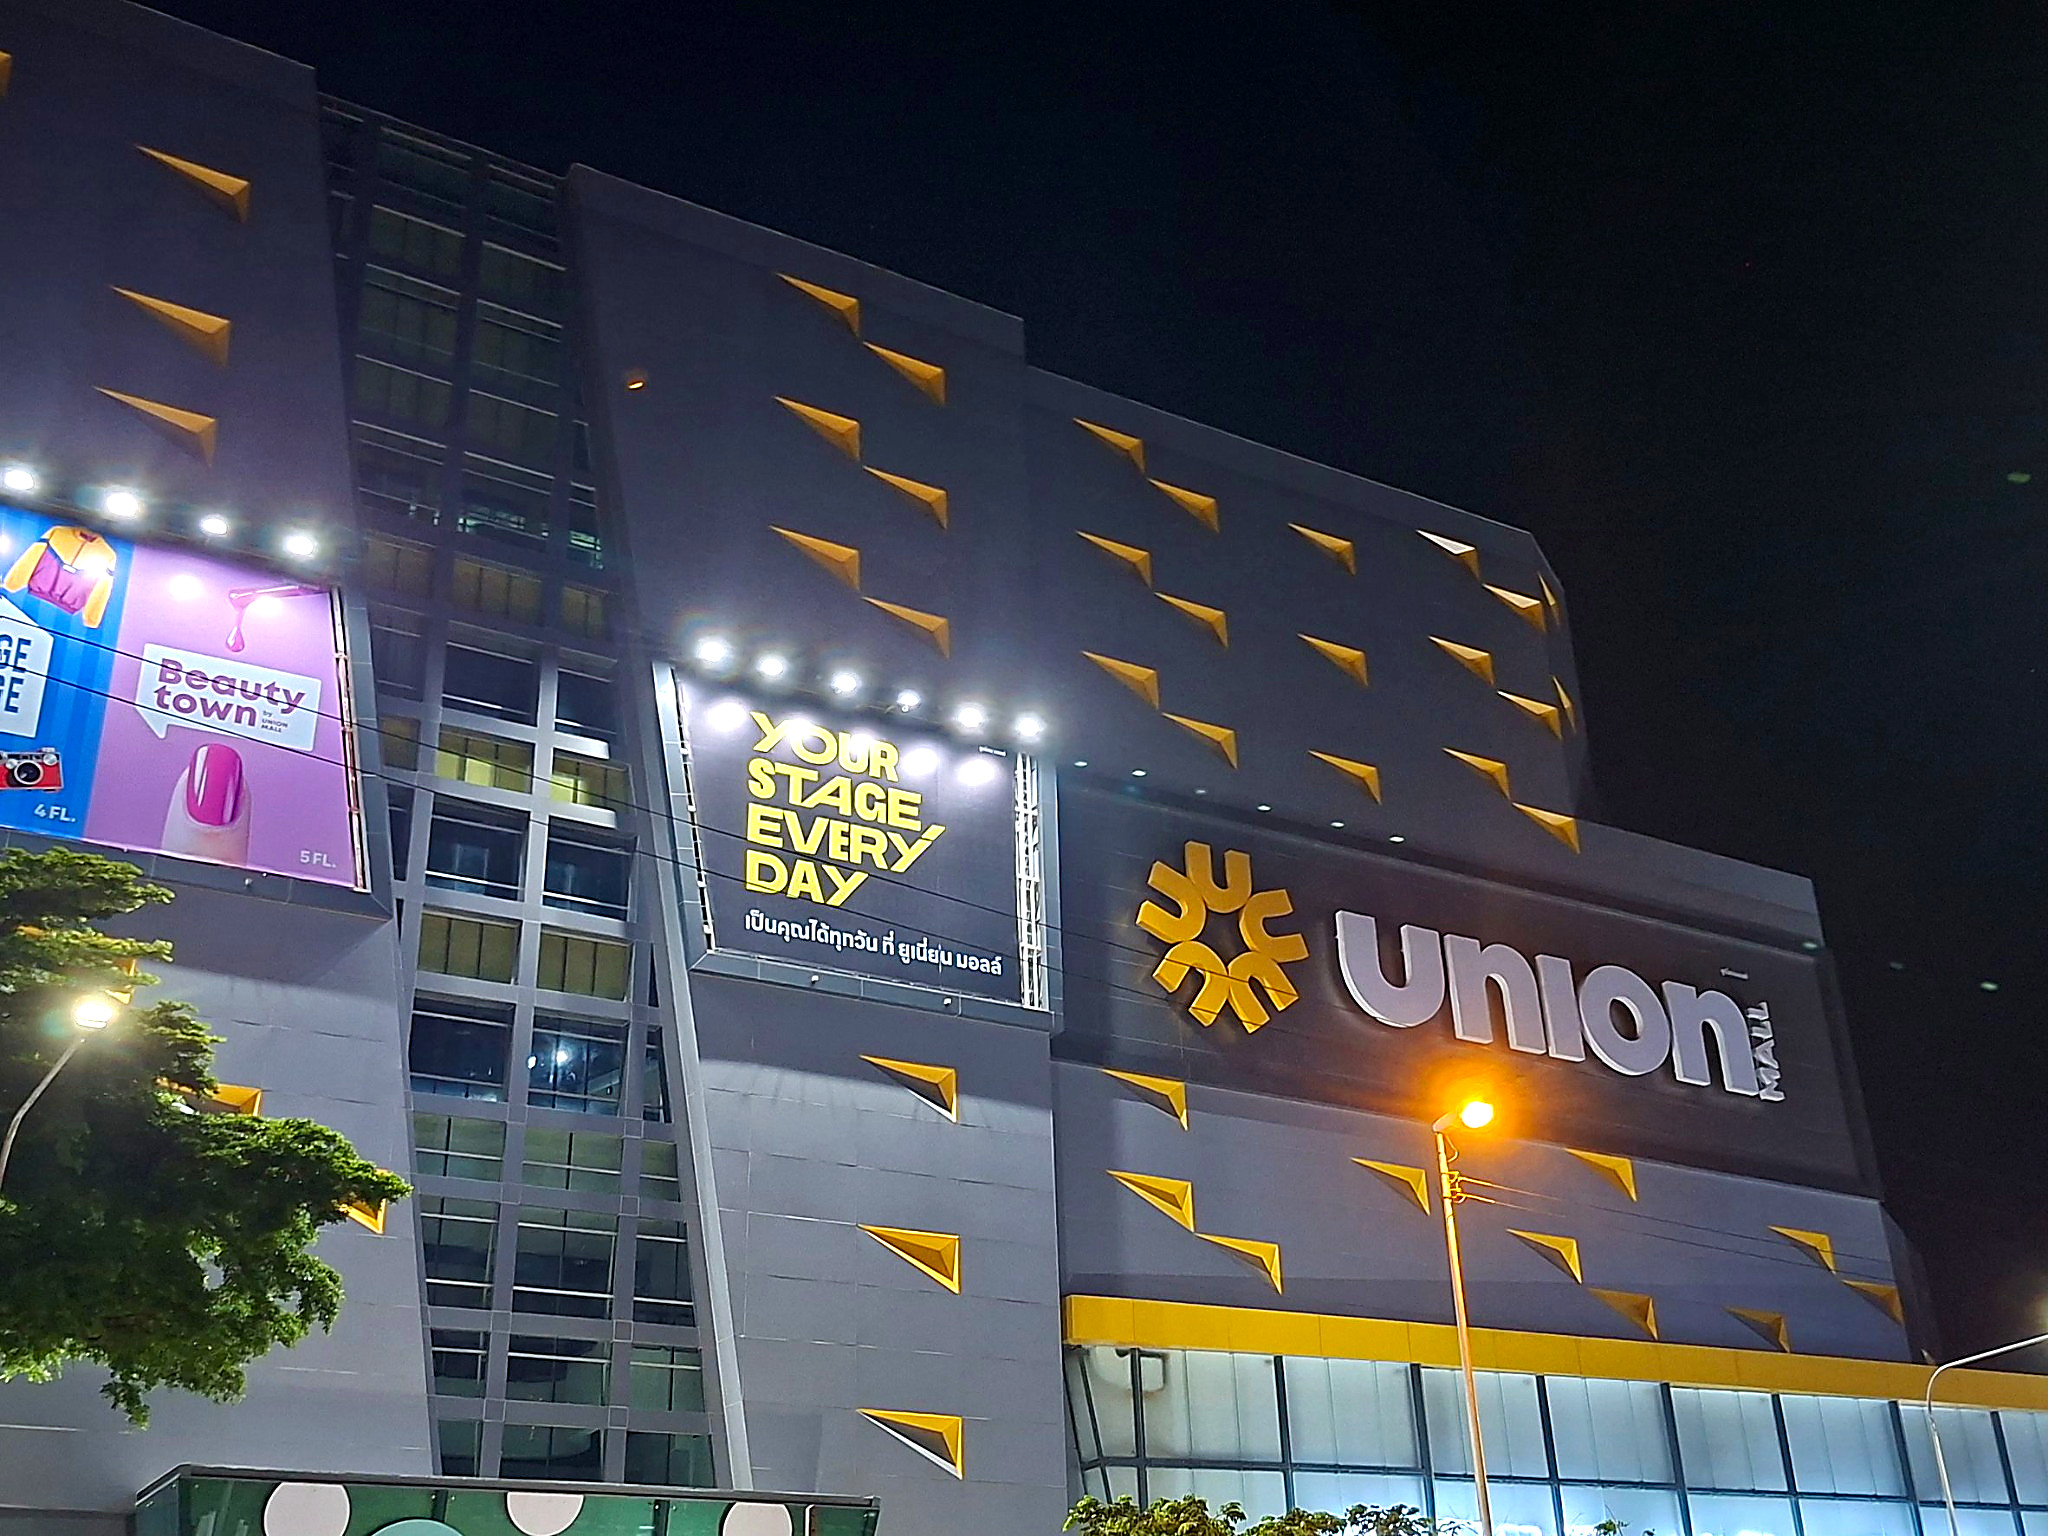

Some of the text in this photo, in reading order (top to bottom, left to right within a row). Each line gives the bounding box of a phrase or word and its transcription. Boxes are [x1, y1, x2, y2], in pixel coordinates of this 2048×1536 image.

[154, 685, 258, 727] town
[159, 658, 306, 714] Beauty
[261, 724, 282, 733] MALL
[262, 718, 288, 728] UNION
[750, 711, 899, 782] YOUR
[33, 803, 76, 823] 4 FL.
[748, 757, 922, 831] STAGE
[299, 850, 337, 868] 5 FL.
[747, 802, 946, 873] EVERY
[746, 849, 869, 907] DAY
[1746, 1001, 1785, 1102] MALL
